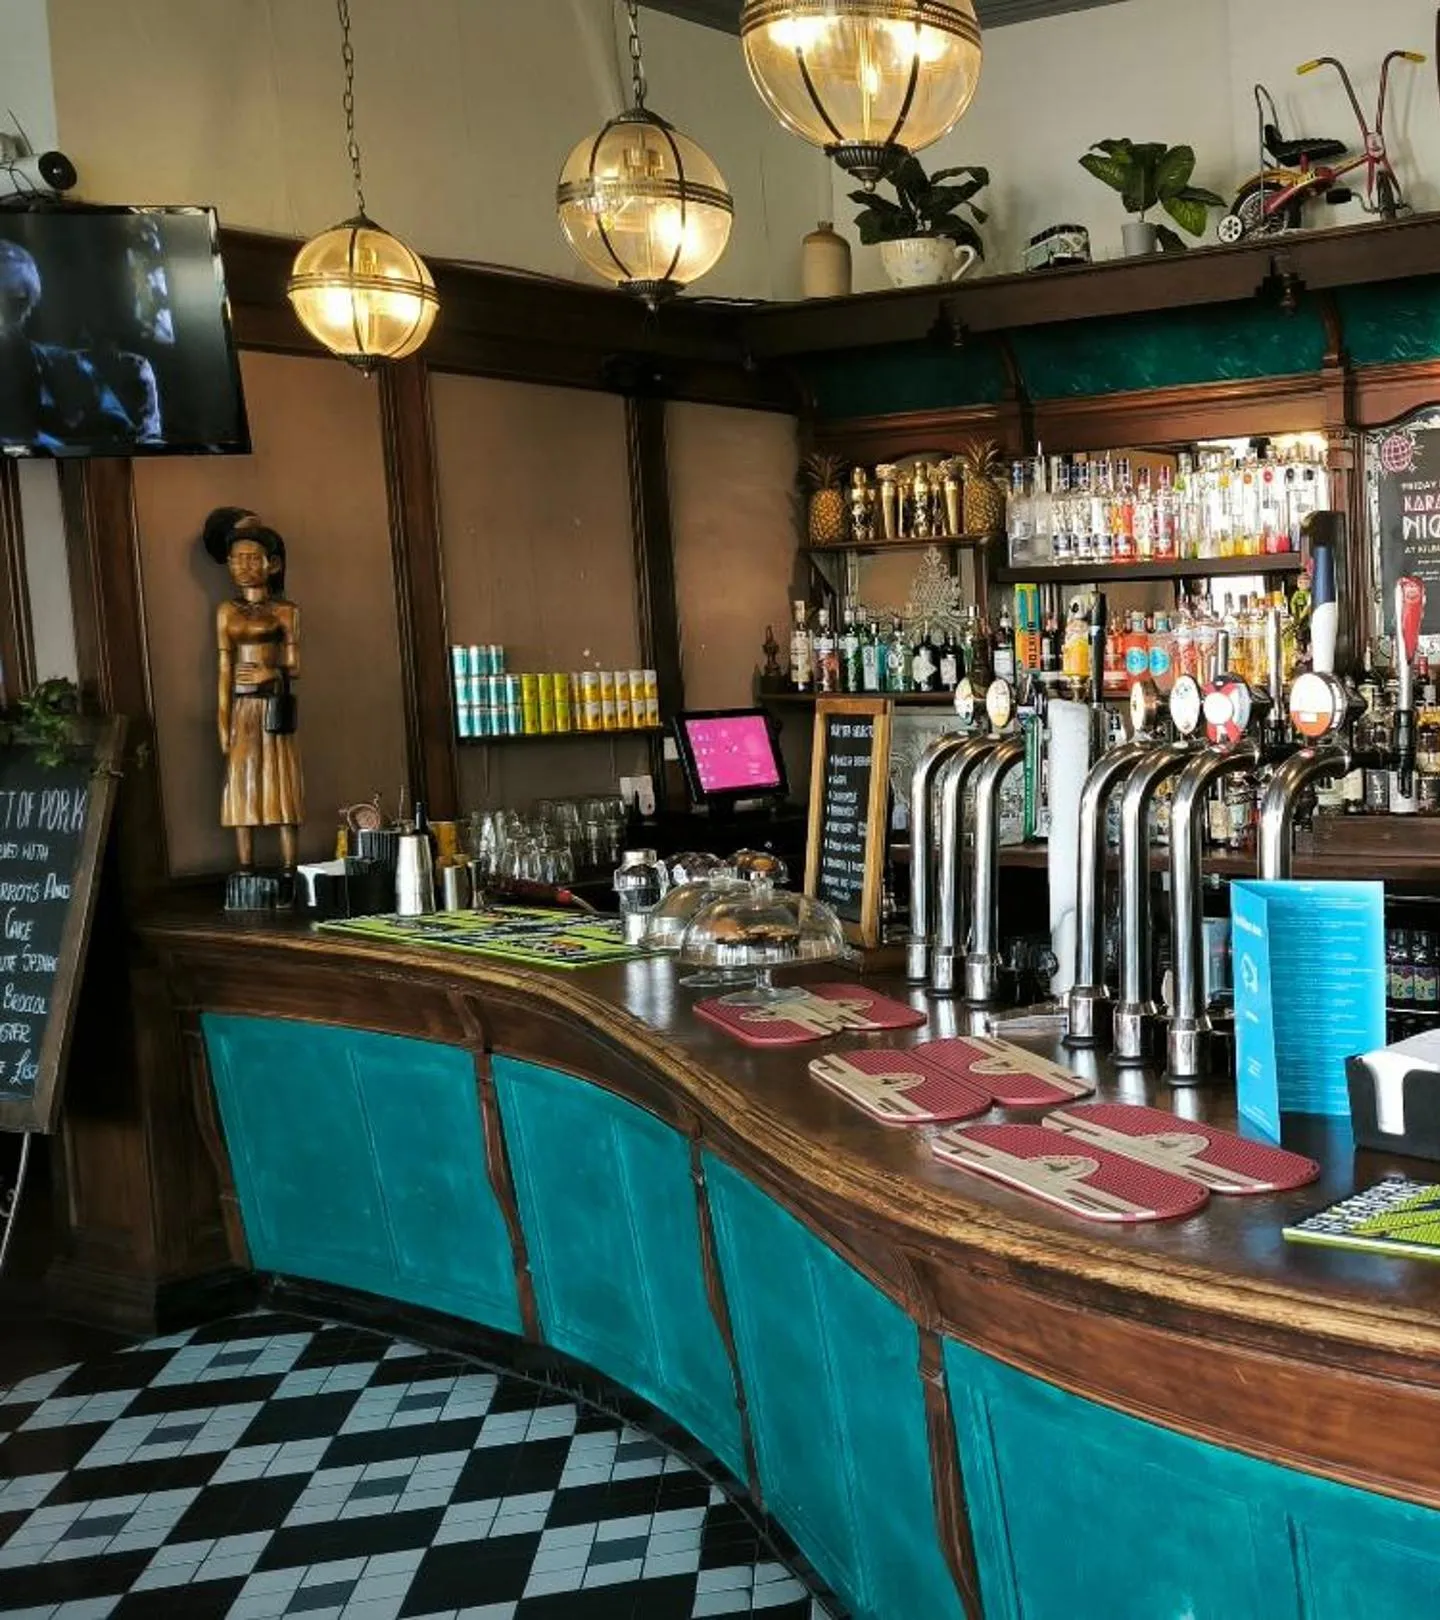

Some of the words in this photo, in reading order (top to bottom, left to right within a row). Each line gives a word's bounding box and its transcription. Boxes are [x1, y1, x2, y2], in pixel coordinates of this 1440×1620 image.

[17, 790, 36, 829] OF
[38, 787, 88, 833] PORK
[43, 872, 71, 900] AND
